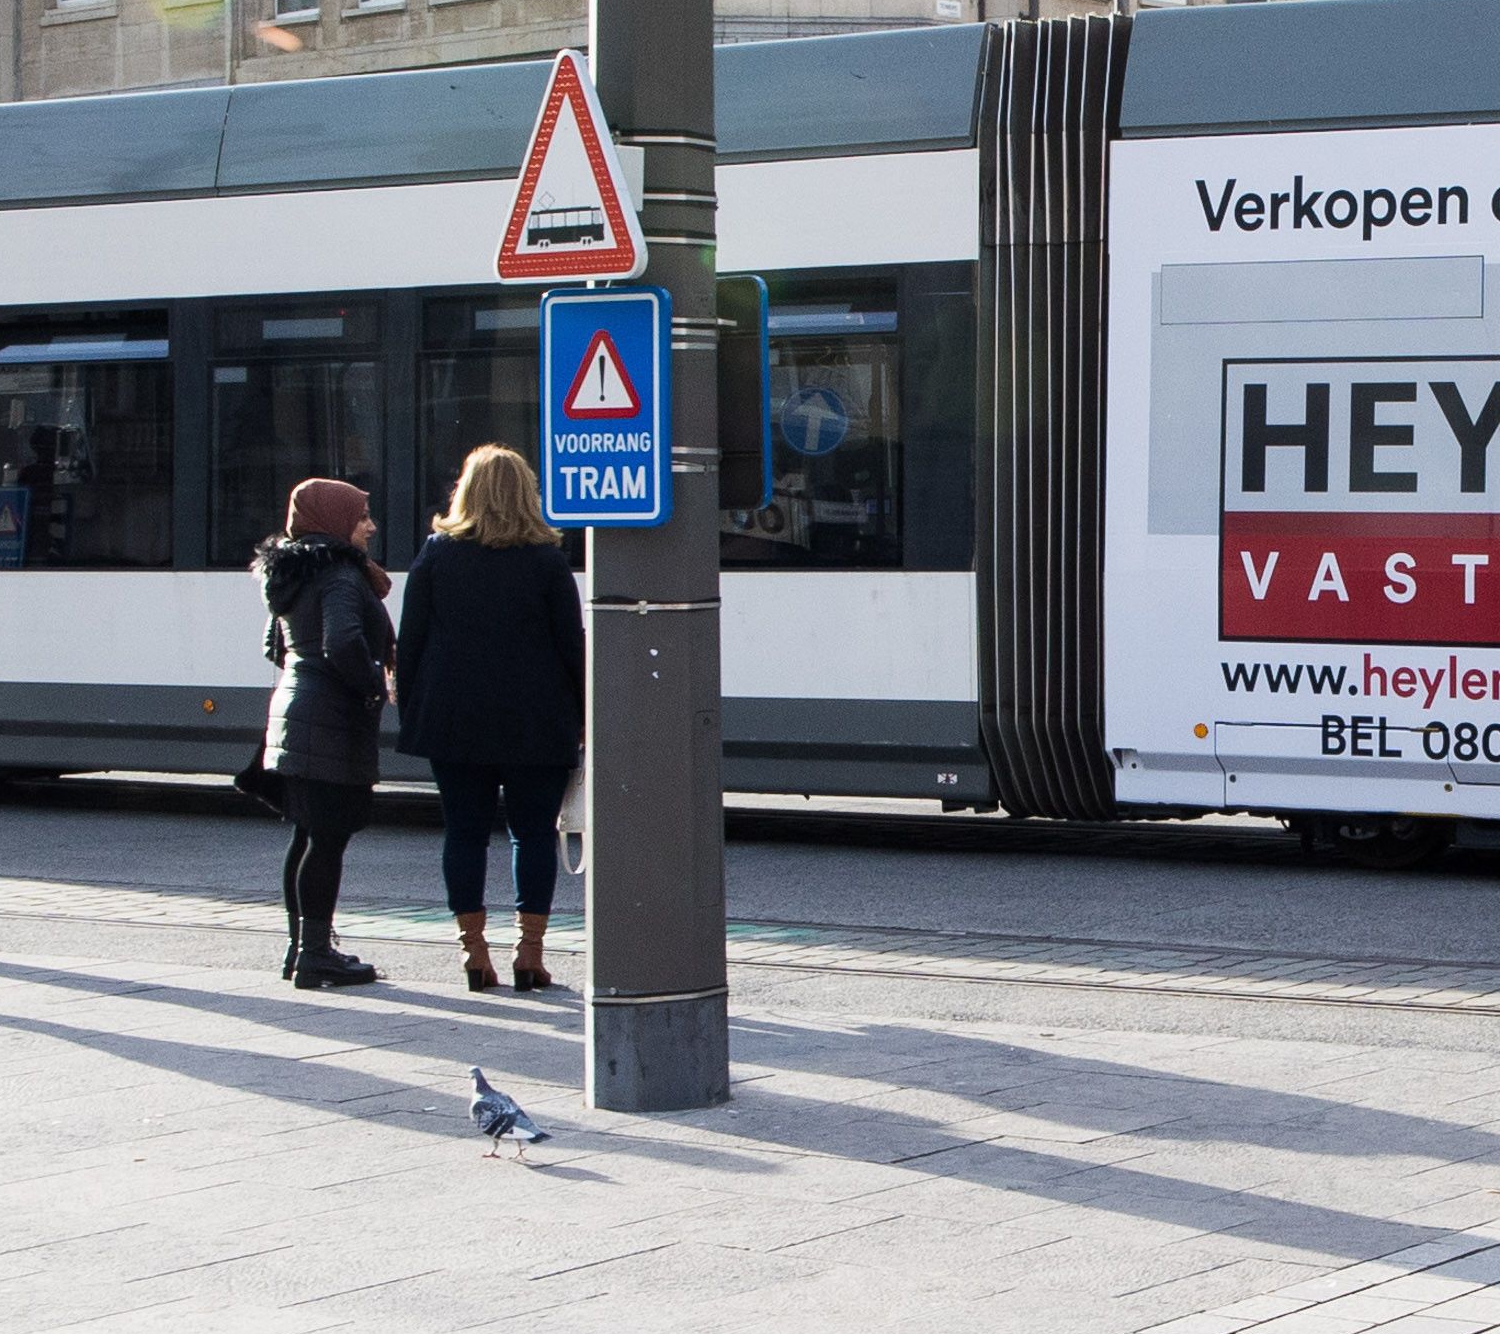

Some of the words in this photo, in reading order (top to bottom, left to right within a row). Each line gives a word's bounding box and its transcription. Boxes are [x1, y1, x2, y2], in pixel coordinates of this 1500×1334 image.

[1195, 174, 1470, 241] Verkopen
[554, 432, 652, 453] VOORRANG
[560, 465, 647, 499] TRAM
[1321, 714, 1402, 758] BEL
